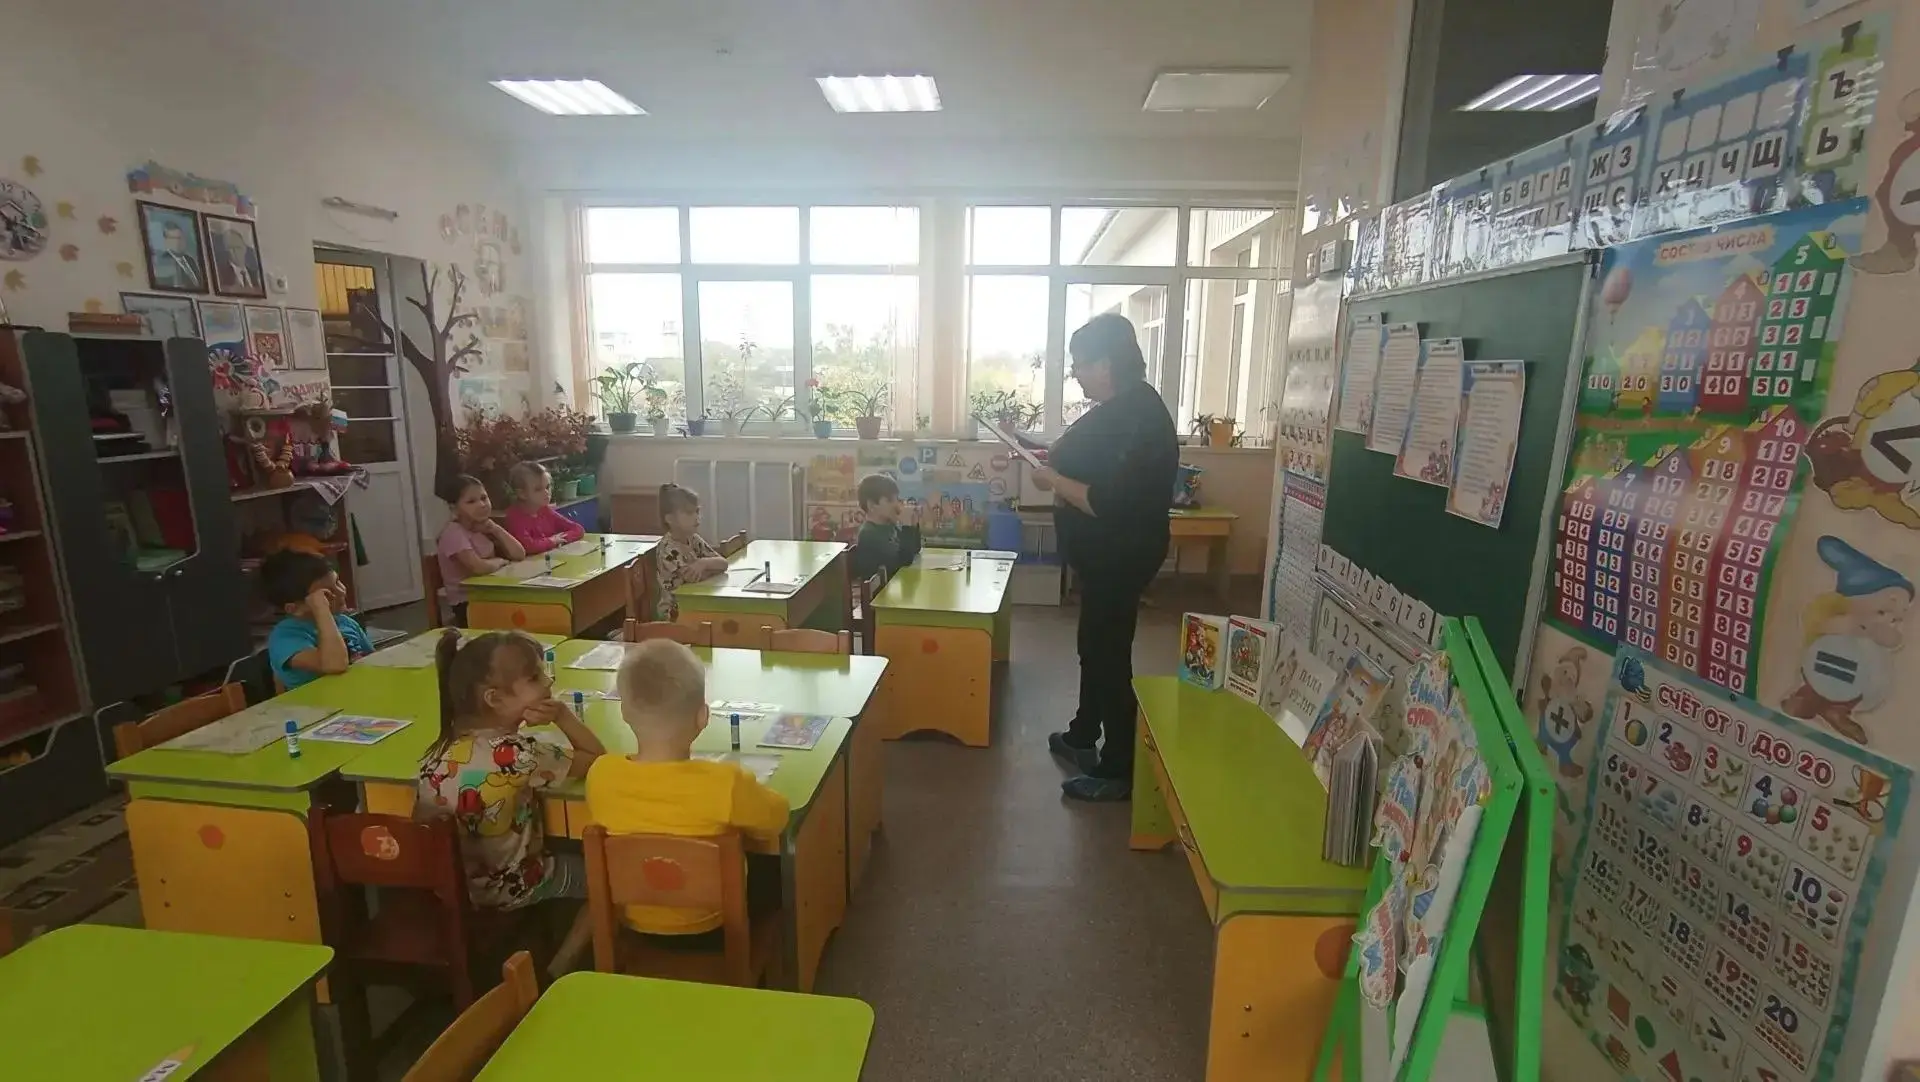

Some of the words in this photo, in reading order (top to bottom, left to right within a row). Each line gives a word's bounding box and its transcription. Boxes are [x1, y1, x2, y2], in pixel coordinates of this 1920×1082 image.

[1830, 70, 1855, 100] Ъ
[1816, 126, 1839, 155] Ь
[1502, 187, 1512, 204] Б
[1520, 181, 1529, 199] В
[1540, 174, 1548, 192] Г
[1557, 166, 1571, 190] Д
[1589, 153, 1611, 180] Ж
[1619, 145, 1632, 168] З
[1555, 201, 1565, 220] Т
[1612, 186, 1625, 208] С
[1656, 170, 1674, 194] Х
[1686, 160, 1705, 186] Ц
[1722, 149, 1739, 174] Ч
[1752, 136, 1781, 168] Щ
[1717, 231, 1766, 251] ЧИСЛА
[1794, 244, 1810, 265] 5
[1778, 275, 1788, 291] 1
[1799, 272, 1811, 289] 4
[1771, 300, 1784, 317] 2
[1793, 299, 1806, 316] 3
[1765, 327, 1777, 344] 3
[1787, 327, 1799, 344] 2
[1711, 353, 1721, 368] 3
[1731, 353, 1739, 369] 1
[1759, 353, 1771, 369] 4
[1783, 352, 1793, 368] 1
[1591, 376, 1597, 388] 1
[1602, 376, 1610, 388] 0
[1623, 377, 1631, 389] 2
[1637, 377, 1646, 389] 0
[1662, 377, 1671, 391] 3
[1679, 377, 1689, 391] 0
[1709, 377, 1718, 392] 4
[1727, 377, 1736, 393] 0
[1757, 378, 1767, 394] 5
[1778, 378, 1789, 395] 0
[1775, 418, 1796, 438] 10
[1717, 436, 1731, 454] 9
[1763, 443, 1773, 458] 1
[1783, 444, 1796, 462] 9
[1668, 456, 1680, 474] 8
[1706, 460, 1715, 476] 1
[1723, 463, 1735, 480] 8
[1624, 473, 1636, 488] 7
[1755, 468, 1767, 484] 2
[1775, 470, 1788, 488] 8
[1698, 484, 1709, 499] 2
[1717, 488, 1729, 503] 7
[1747, 493, 1758, 509] 3
[1768, 497, 1781, 514] 7
[1573, 502, 1581, 515] 1
[1584, 505, 1593, 519] 5
[1605, 512, 1614, 525] 2
[1618, 514, 1627, 528] 5
[1569, 522, 1577, 534] 2
[1581, 525, 1588, 539] 4
[1640, 520, 1650, 534] 3
[1656, 523, 1666, 539] 5
[1738, 518, 1750, 533] 4
[1758, 522, 1772, 539] 6
[1568, 542, 1575, 554] 3
[1602, 532, 1609, 545] 3
[1614, 535, 1623, 550] 4
[1637, 541, 1645, 555] 4
[1652, 545, 1660, 560] 4
[1682, 531, 1693, 546] 4
[1699, 535, 1711, 550] 5
[1612, 556, 1619, 570] 3
[1729, 542, 1742, 559] 5
[1750, 547, 1762, 564] 5
[1577, 566, 1584, 579] 2
[1635, 563, 1642, 578] 5
[1649, 568, 1657, 583] 3
[1676, 554, 1686, 568] 5
[1695, 559, 1704, 574] 4
[1565, 580, 1571, 593] 5
[1597, 573, 1604, 586] 5
[1609, 578, 1617, 591] 2
[1674, 577, 1683, 592] 6
[1692, 582, 1701, 598] 3
[1723, 567, 1734, 583] 6
[1743, 573, 1754, 588] 4
[1322, 549, 1327, 563] 0
[1330, 556, 1335, 569] 1
[1339, 562, 1346, 576] 2
[1351, 571, 1357, 585] 3
[1363, 579, 1370, 594] 4
[1376, 585, 1383, 601] 5
[1389, 596, 1397, 612] 6
[1405, 604, 1413, 621] 7
[1417, 612, 1427, 630] 8
[1633, 585, 1641, 599] 6
[1648, 591, 1656, 606] 2
[1575, 604, 1582, 618] 0
[1672, 599, 1681, 613] 7
[1690, 606, 1699, 621] 2
[1720, 592, 1730, 607] 7
[1740, 598, 1749, 614] 3
[1323, 607, 1330, 628] 0
[1332, 616, 1338, 640] 1
[1341, 623, 1350, 646] 2
[1594, 613, 1602, 626] 7
[1607, 618, 1614, 632] 0
[1631, 607, 1640, 621] 7
[1647, 614, 1653, 628] 1
[1717, 616, 1727, 632] 8
[1736, 624, 1747, 640] 2
[1629, 628, 1637, 643] 8
[1644, 635, 1652, 649] 0
[1670, 622, 1679, 638] 8
[1687, 631, 1695, 645] 1
[1668, 645, 1678, 660] 9
[1685, 653, 1694, 668] 0
[1715, 642, 1725, 658] 9
[1735, 650, 1743, 665] 1
[1710, 665, 1725, 682] 10
[1732, 674, 1742, 690] 0
[1623, 701, 1631, 721] 1
[1657, 683, 1703, 721] СЧЁТ
[1703, 707, 1731, 736] ОТ
[1735, 721, 1747, 746] 1
[1750, 731, 1794, 767] ДО
[1796, 751, 1834, 788] 20
[1659, 722, 1673, 744] 2
[1607, 754, 1618, 773] 6
[1704, 746, 1718, 769] 3
[1644, 775, 1658, 796] 7
[1755, 775, 1772, 798] 4
[1601, 802, 1615, 826] 11
[1687, 804, 1702, 827] 8
[1811, 805, 1831, 831] 5
[1637, 828, 1658, 858] 12
[1736, 834, 1753, 857] 9
[1590, 850, 1608, 878] 16
[1680, 858, 1702, 890] 13
[1628, 880, 1649, 907] 17
[1793, 867, 1822, 904] 10
[1726, 892, 1751, 925] 14
[1668, 911, 1691, 945] 18
[1781, 931, 1810, 969] 15
[1716, 950, 1741, 983] 19
[1763, 994, 1799, 1034] 20
